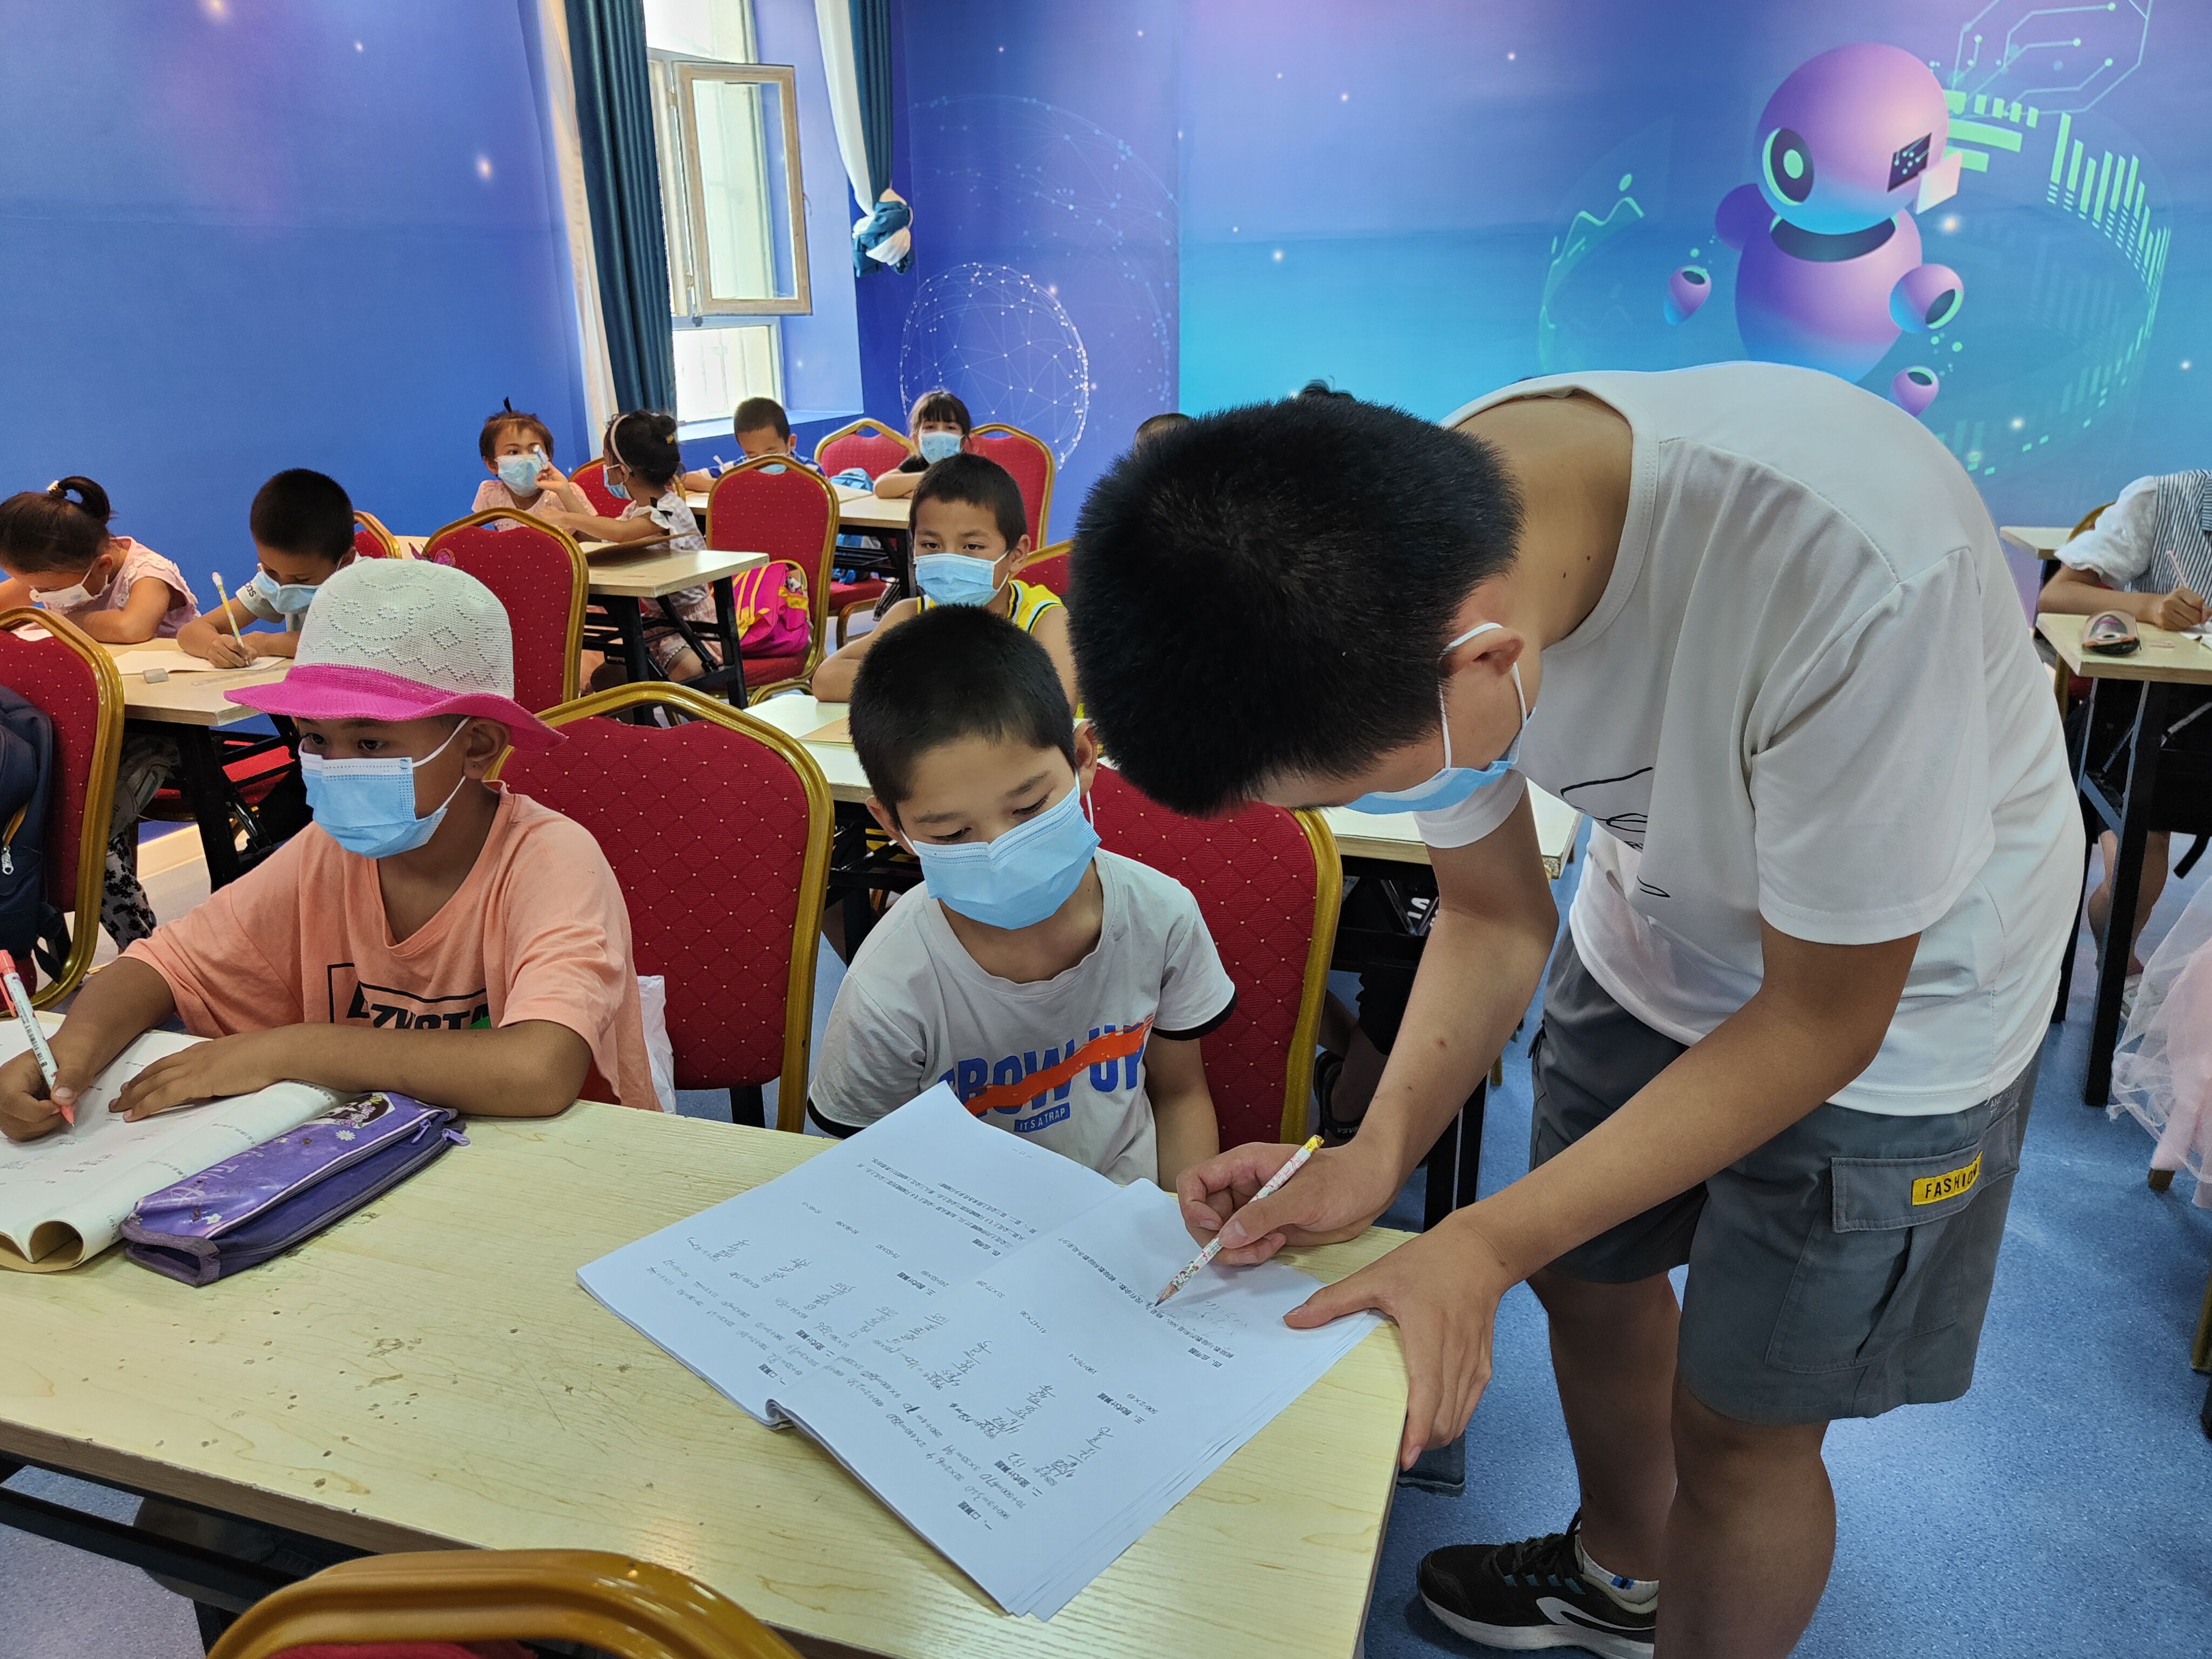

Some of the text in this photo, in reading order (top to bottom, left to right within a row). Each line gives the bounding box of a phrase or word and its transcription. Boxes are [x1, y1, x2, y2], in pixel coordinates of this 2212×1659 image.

[1044, 1108, 1065, 1123] TRAP
[1925, 1163, 1978, 1198] FASHION
[1020, 1311, 1046, 1333] 41+47×36
[1068, 1354, 1097, 1374] 190+76×4
[1188, 1347, 1223, 1368] 四、应用题
[1127, 1394, 1158, 1414] 506-2×49
